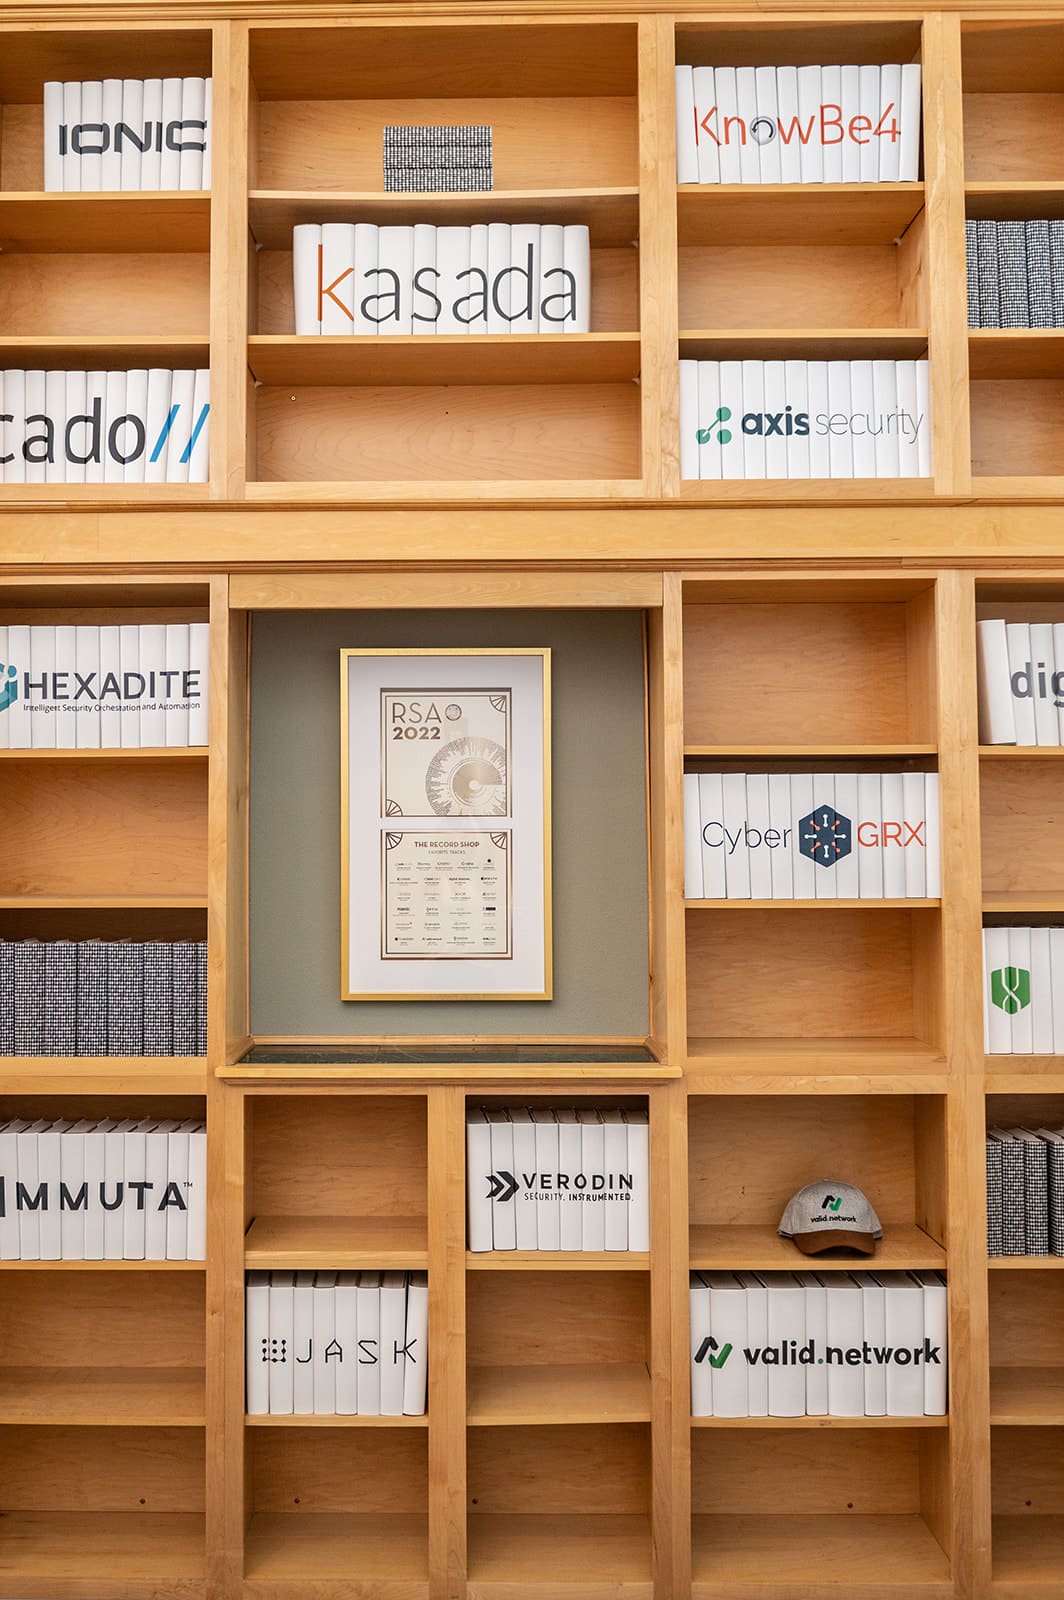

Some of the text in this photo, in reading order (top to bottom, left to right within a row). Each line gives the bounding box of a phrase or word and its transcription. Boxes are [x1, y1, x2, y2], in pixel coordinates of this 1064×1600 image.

[58, 119, 207, 156] IONIC
[693, 102, 902, 147] KnowBe4
[317, 243, 577, 323] kasada
[741, 405, 924, 444] axis security
[23, 670, 201, 700] HEXADITE
[62, 703, 94, 713] Security
[142, 702, 157, 711] and
[392, 702, 442, 724] RSA
[393, 726, 441, 741] 2022
[702, 820, 927, 855] Cyber GRX
[523, 1173, 633, 1190] VERODIN
[296, 1338, 417, 1365] JASK
[743, 1338, 941, 1366] valid.network
